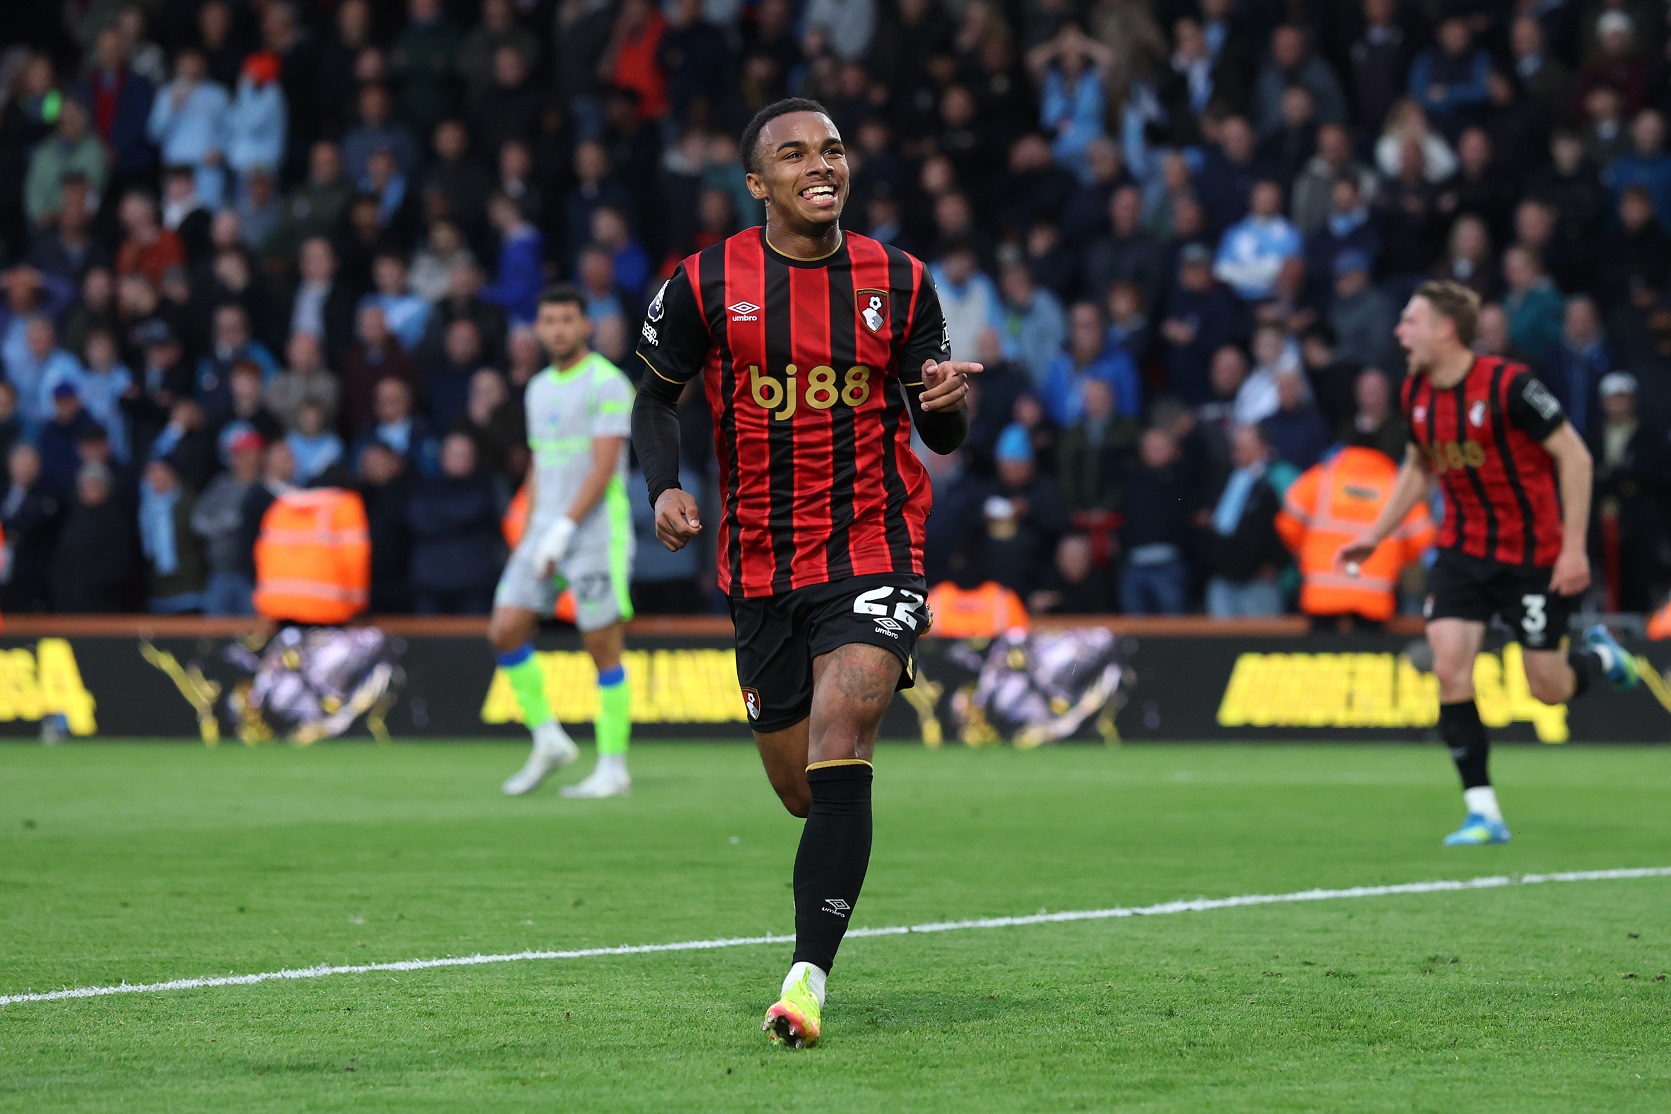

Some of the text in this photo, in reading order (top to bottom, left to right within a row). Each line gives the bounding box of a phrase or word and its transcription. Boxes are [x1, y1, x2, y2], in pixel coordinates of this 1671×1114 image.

[732, 314, 758, 322] umbro
[749, 363, 871, 421] bj88
[853, 586, 925, 631] 22
[1521, 594, 1548, 633] 3
[874, 626, 899, 640] umbro
